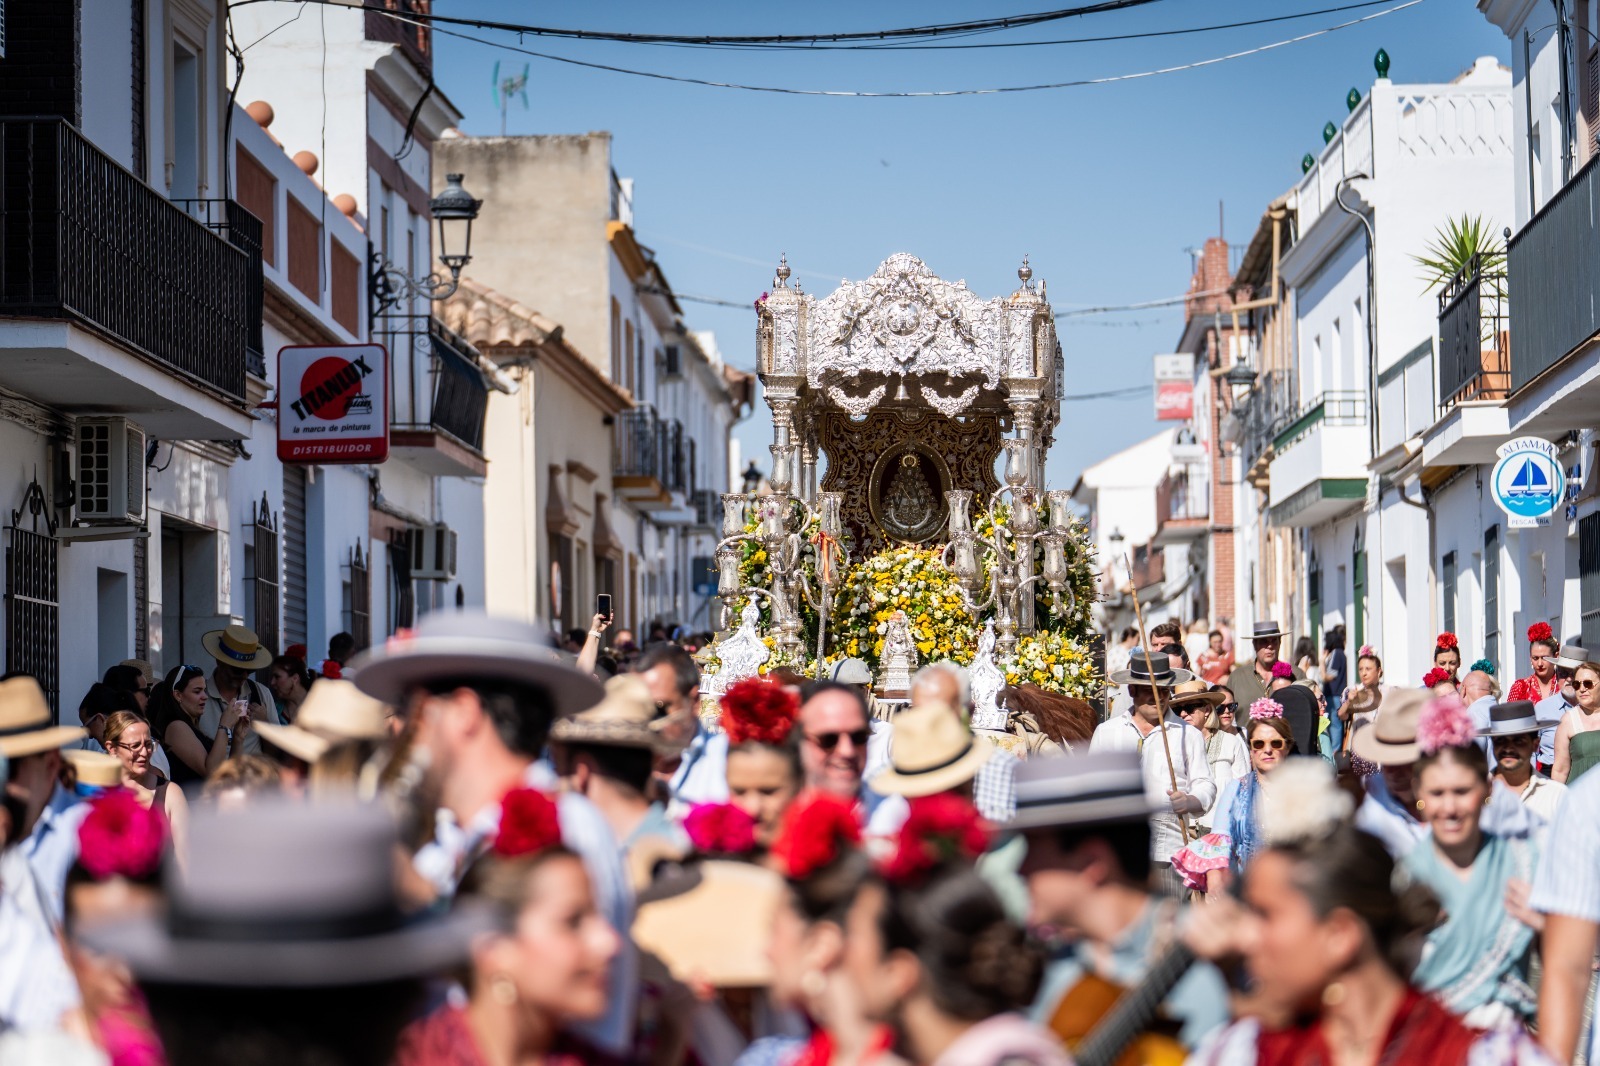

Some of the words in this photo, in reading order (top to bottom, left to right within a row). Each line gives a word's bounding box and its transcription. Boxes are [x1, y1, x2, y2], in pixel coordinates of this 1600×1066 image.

[290, 354, 373, 421] TITANLUX
[341, 424, 371, 432] pinturas
[293, 444, 372, 455] DISTRIBUIDOR
[1503, 440, 1553, 456] ALTAMAR
